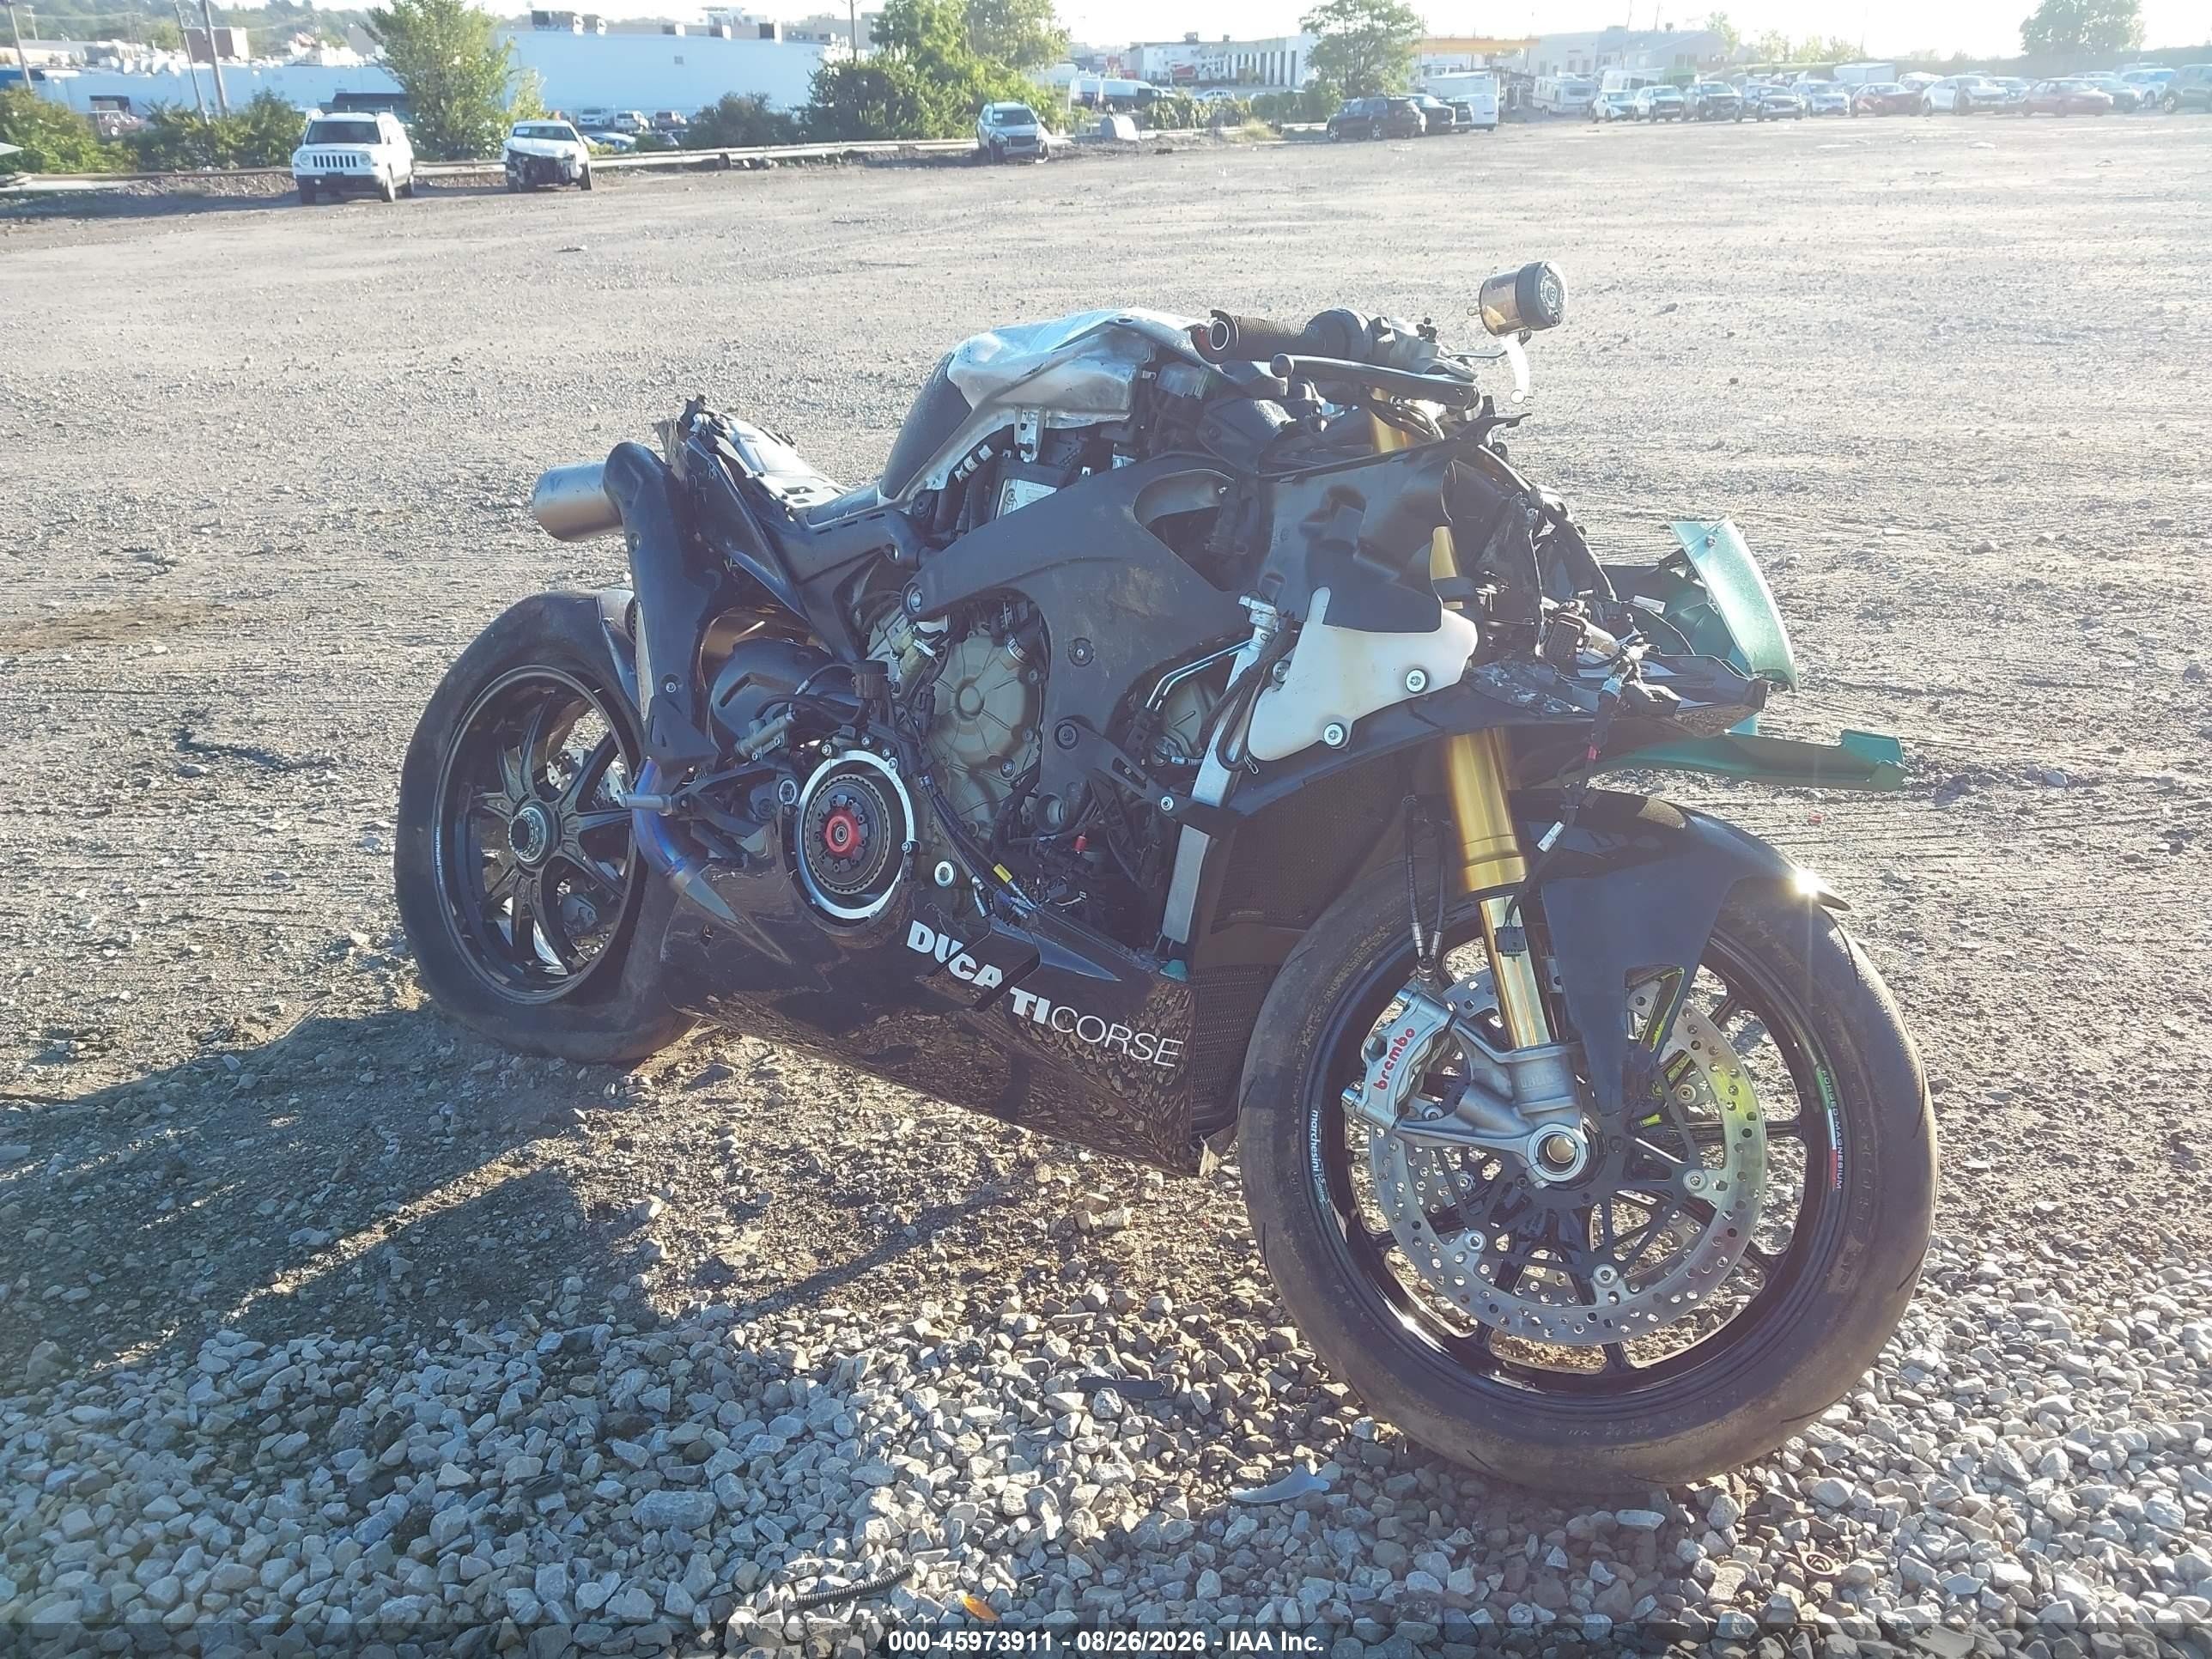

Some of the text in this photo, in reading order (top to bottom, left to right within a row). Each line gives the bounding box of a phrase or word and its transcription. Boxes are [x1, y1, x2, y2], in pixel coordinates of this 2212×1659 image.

[1051, 1006, 1184, 1068] CORSE
[1373, 1028, 1415, 1091] brembo
[1310, 1109, 1322, 1172] marchesini
